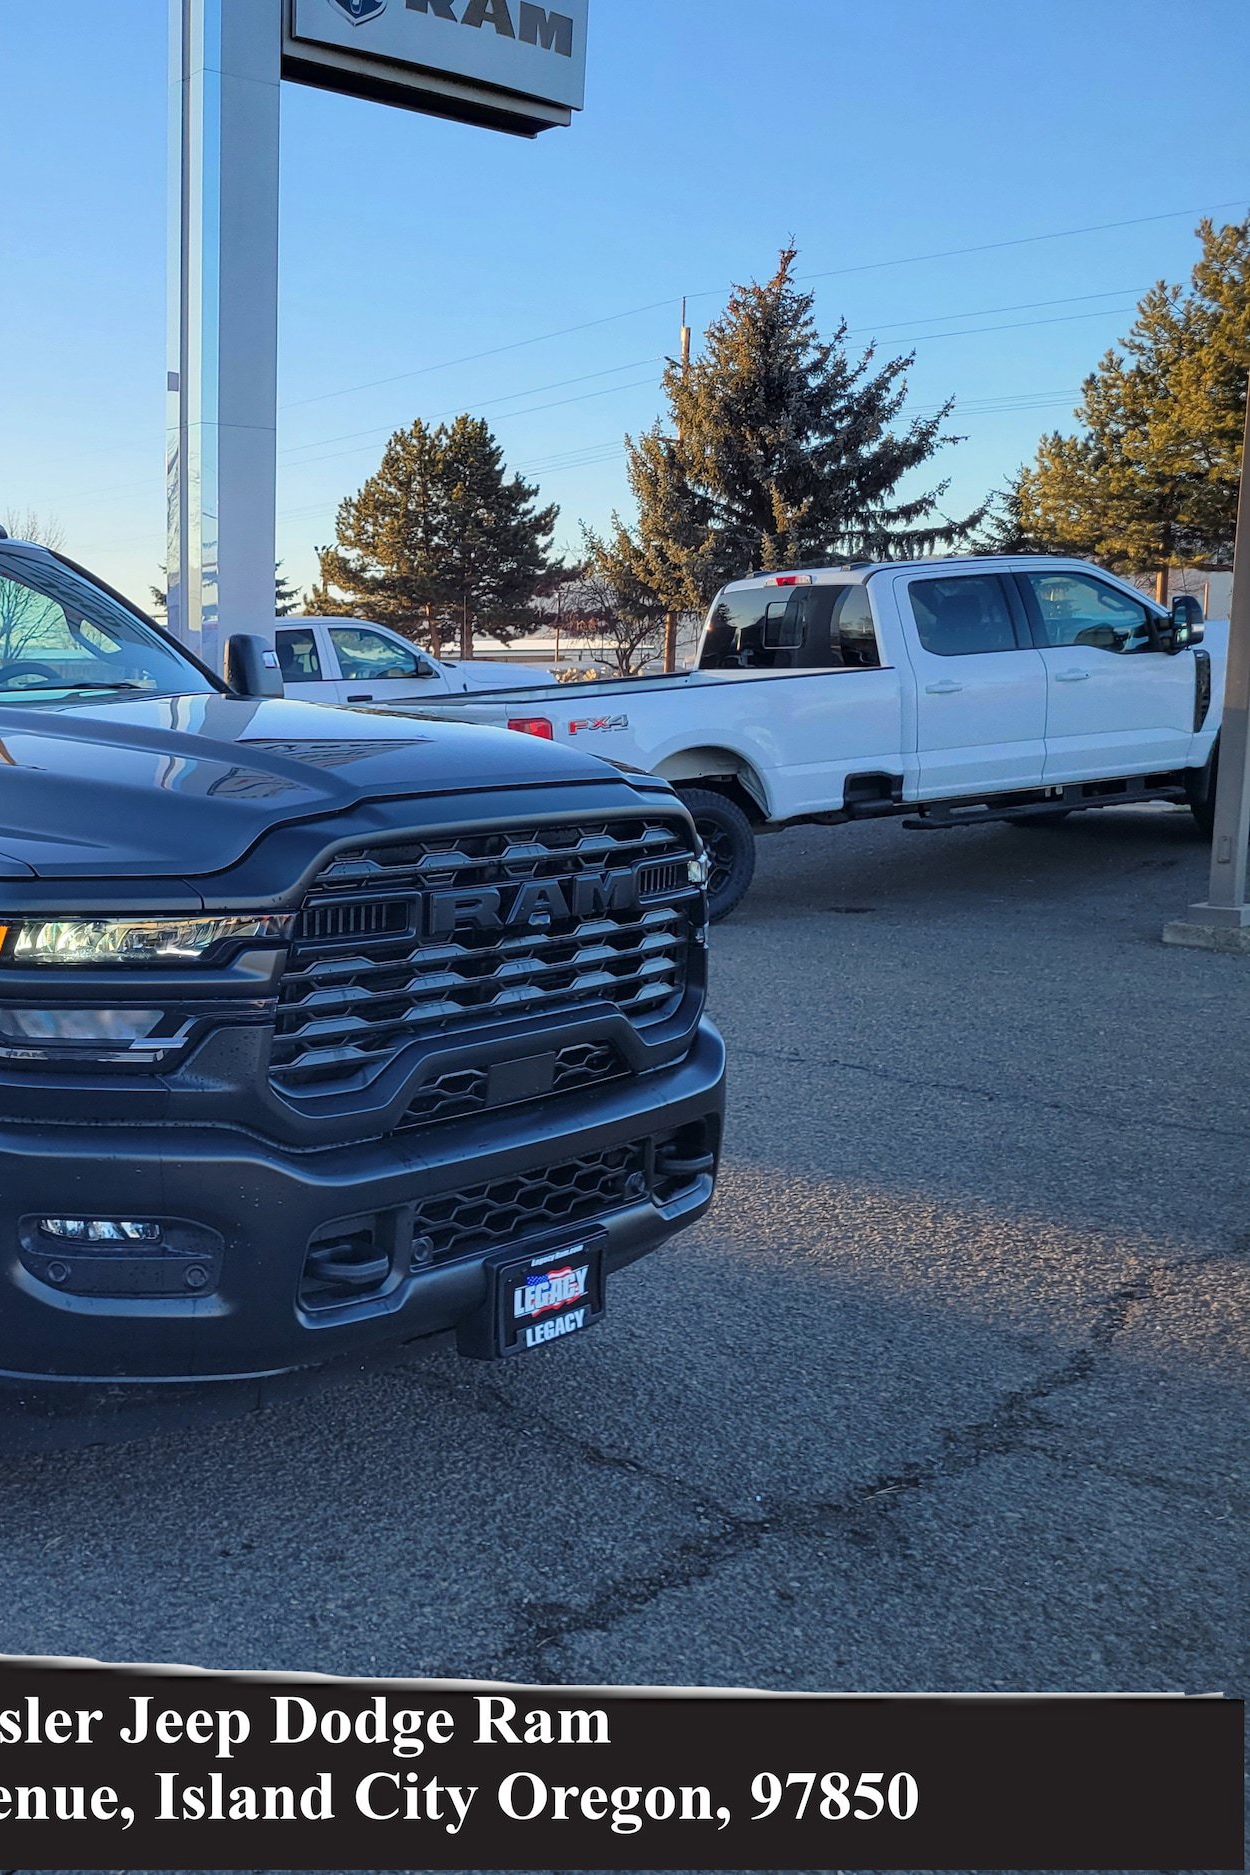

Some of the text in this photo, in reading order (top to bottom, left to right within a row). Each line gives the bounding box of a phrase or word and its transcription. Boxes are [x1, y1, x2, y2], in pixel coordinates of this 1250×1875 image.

[568, 714, 628, 735] FX4
[429, 868, 632, 936] RAM
[514, 1267, 588, 1317] LEGACY
[526, 1309, 585, 1347] LEGACY
